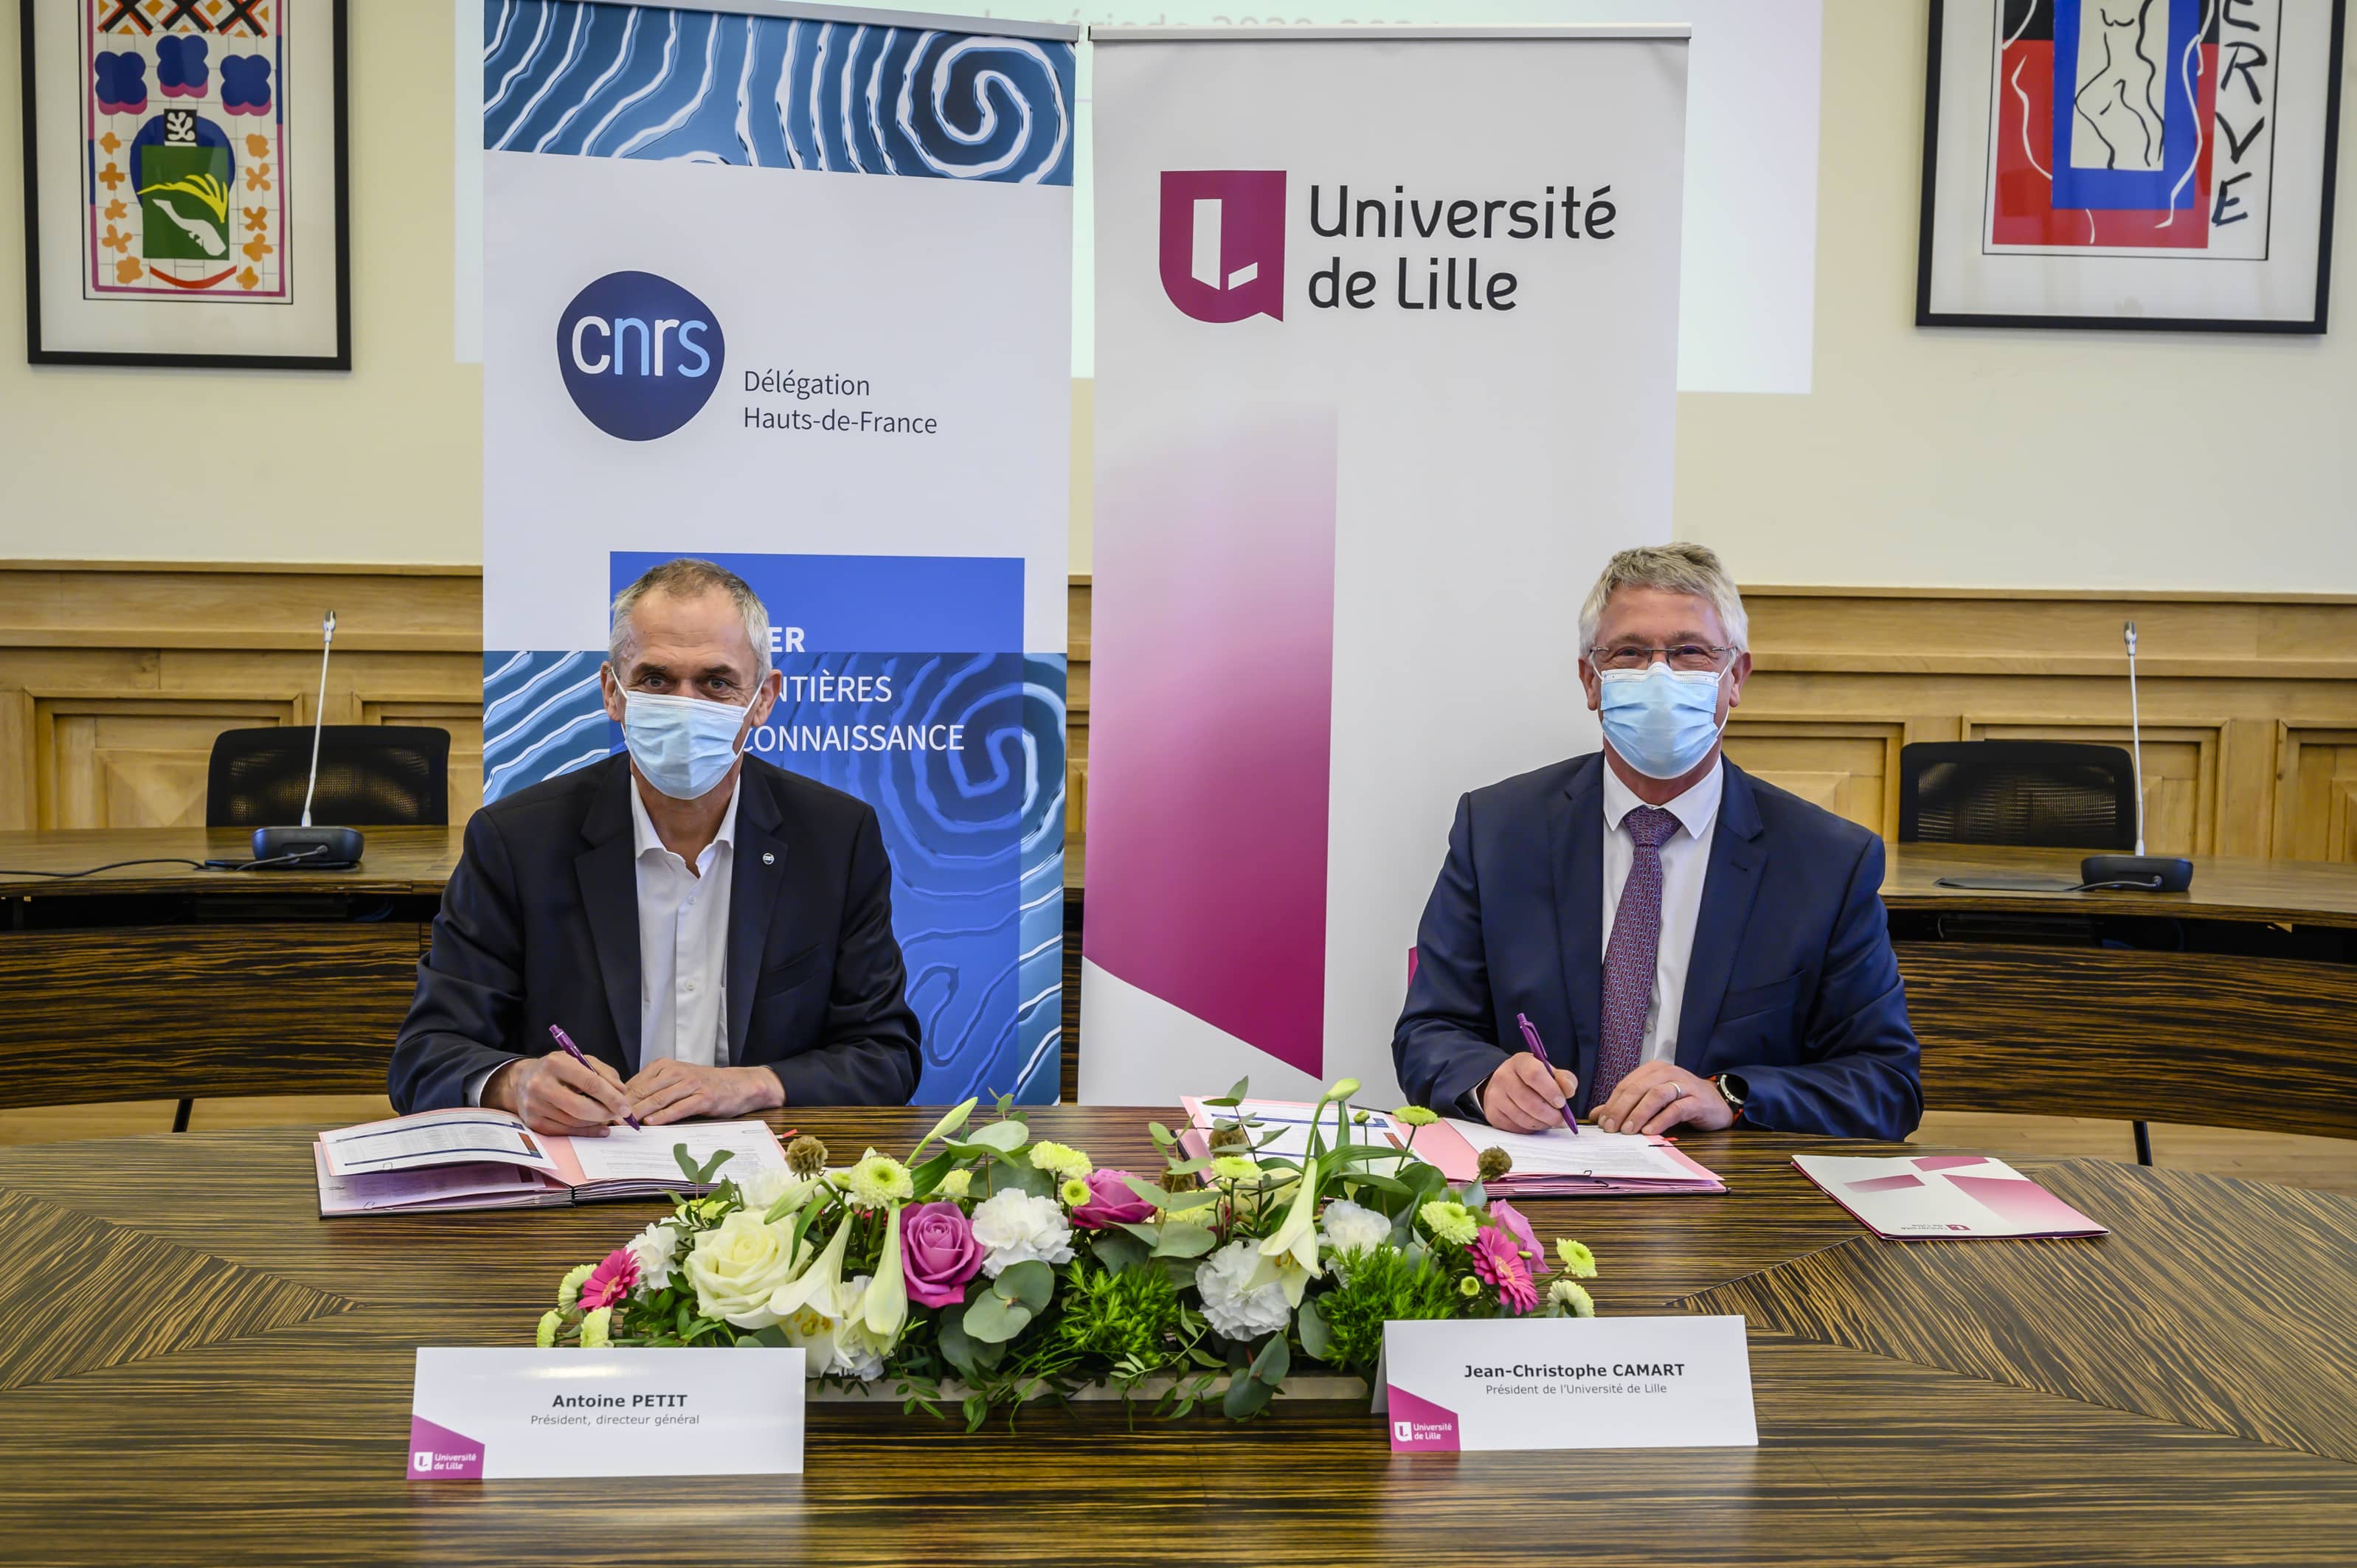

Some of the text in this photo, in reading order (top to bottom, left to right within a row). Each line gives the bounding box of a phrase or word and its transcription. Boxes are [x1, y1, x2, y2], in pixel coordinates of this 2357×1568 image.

[1310, 184, 1617, 240] Université
[1308, 256, 1518, 311] de Lille
[572, 315, 711, 378] cnrs
[744, 369, 871, 400] Délégation
[744, 407, 938, 434] Hauts-de-France
[1464, 1363, 1685, 1380] Jean-Christophe CAMART
[1486, 1384, 1540, 1395] Président
[1543, 1384, 1557, 1395] de
[1627, 1384, 1641, 1393] de
[1644, 1384, 1667, 1393] Lille
[552, 1394, 688, 1408] Antoine PETIT
[530, 1414, 699, 1426] Président, directeur général
[1413, 1423, 1452, 1432] Université
[1414, 1432, 1441, 1440] de Lille
[435, 1454, 477, 1462] Université
[434, 1462, 463, 1470] de Lille
